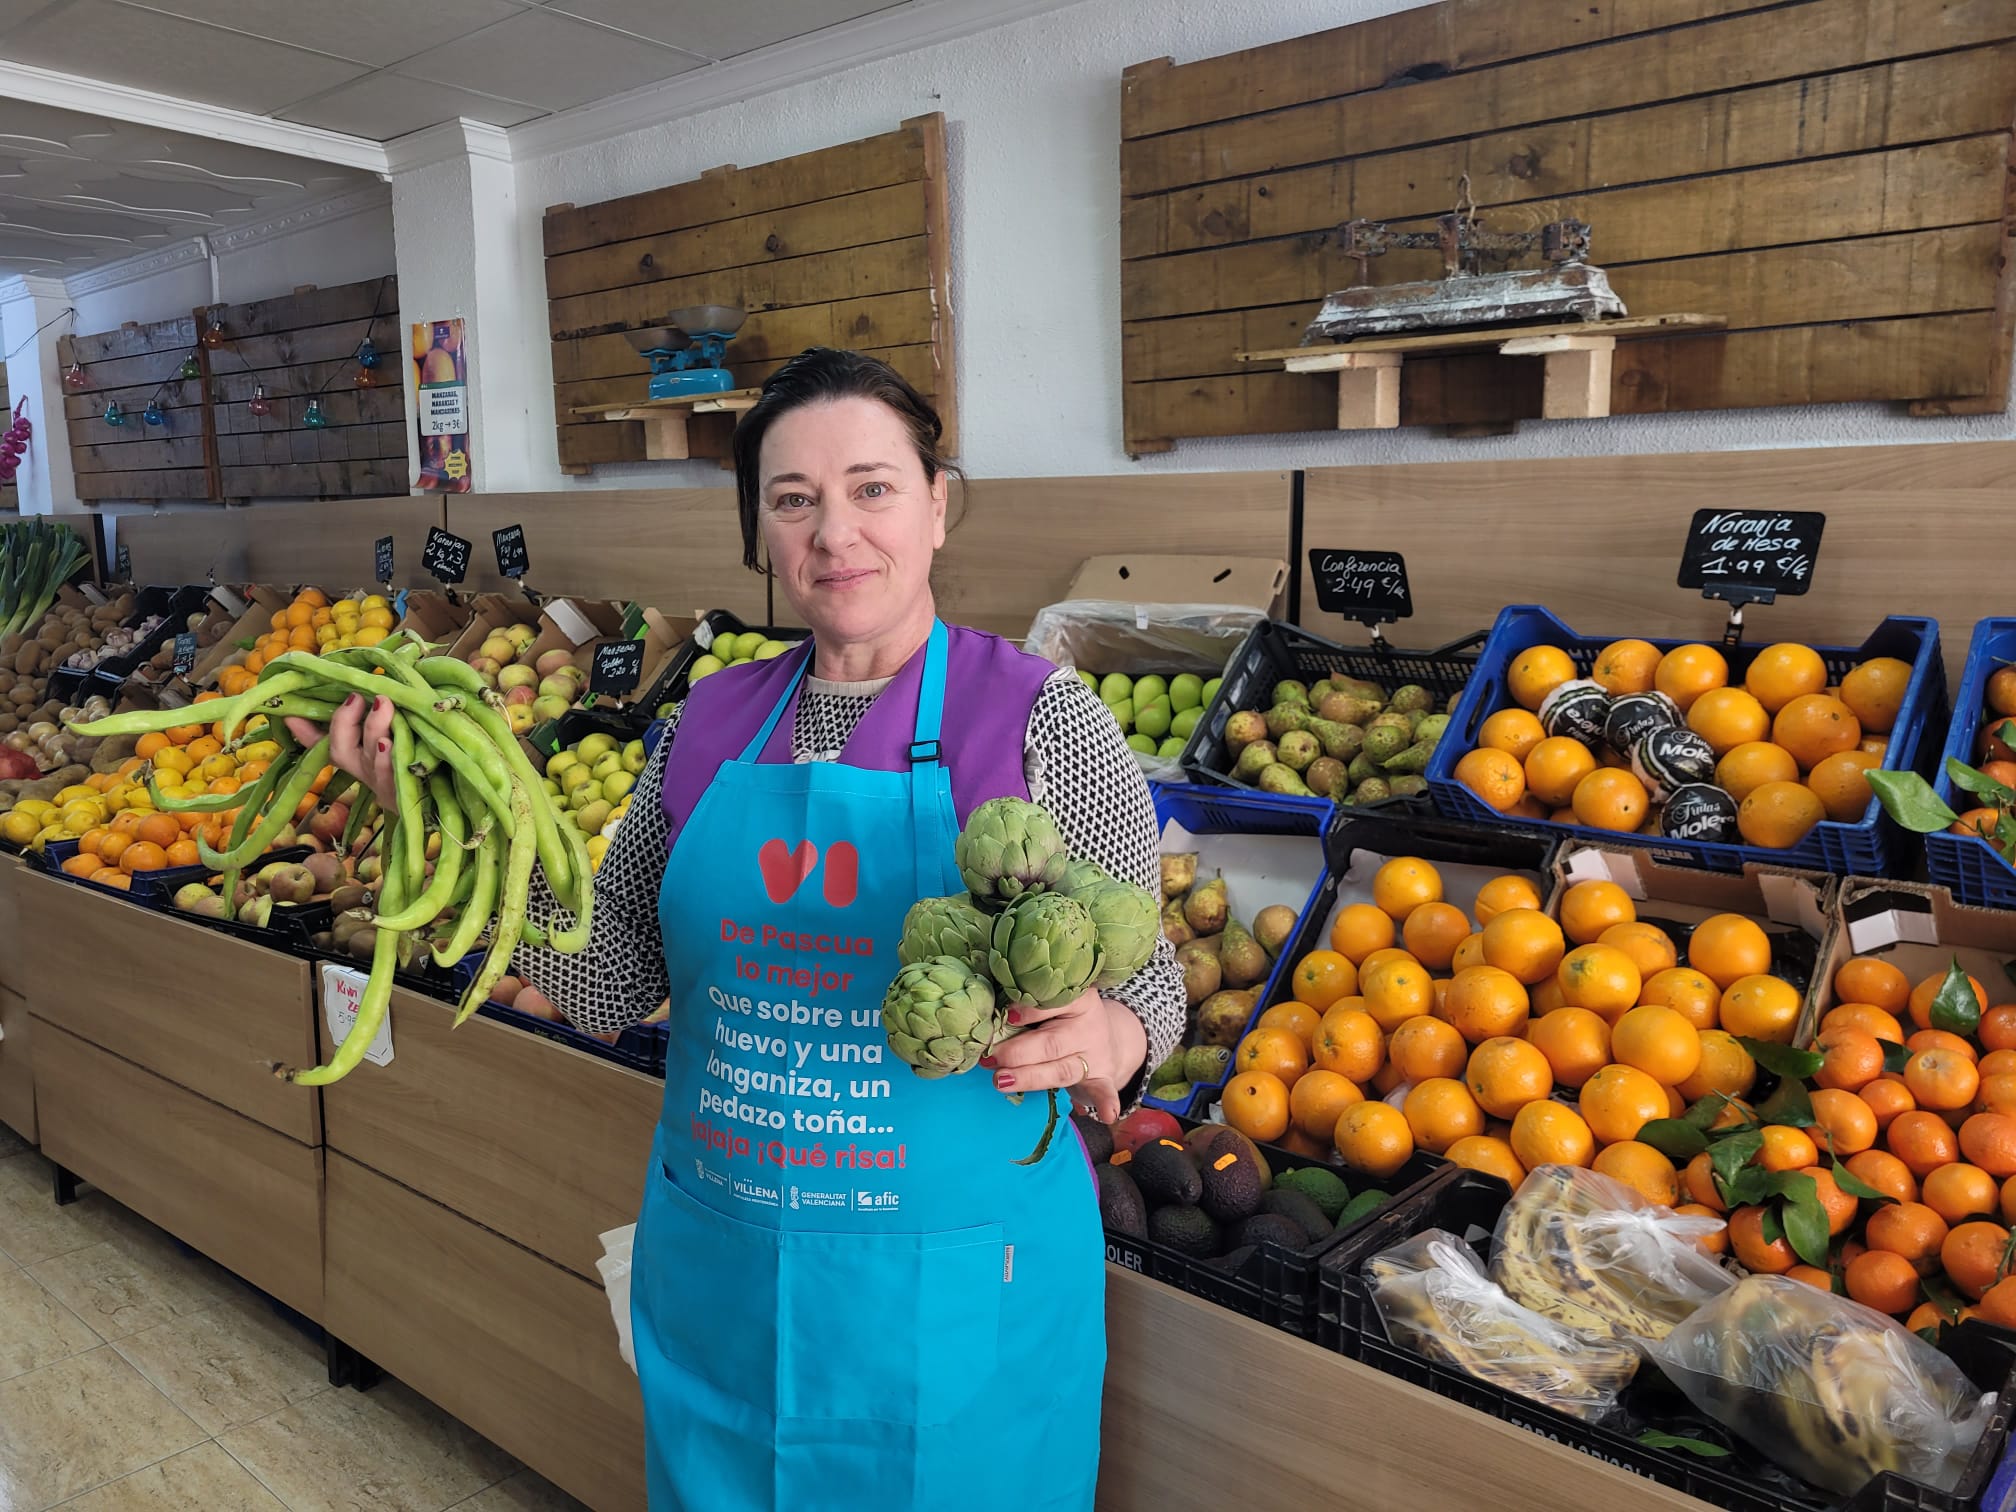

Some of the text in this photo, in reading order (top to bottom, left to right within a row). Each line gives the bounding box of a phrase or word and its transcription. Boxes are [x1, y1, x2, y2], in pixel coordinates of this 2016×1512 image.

[432, 421, 444, 432] 2kg
[1700, 512, 1793, 537] Naranja
[1711, 535, 1739, 551] de
[720, 919, 874, 956] De Pascua
[736, 956, 854, 997] lo mejor
[708, 986, 752, 1016] Que
[757, 1000, 843, 1028] sobre
[715, 1017, 883, 1068] huevo y una
[706, 1049, 891, 1102] longaniza, un
[699, 1087, 895, 1134] pedazo toña...
[757, 1141, 827, 1169] ¡Qué
[835, 1144, 907, 1169] risa!
[733, 1180, 779, 1200] VILLENA
[801, 1191, 847, 1200] GENERALITAT
[801, 1198, 846, 1207] VALENCIANA
[874, 1191, 900, 1206] afic
[1107, 1244, 1143, 1272] OLER
